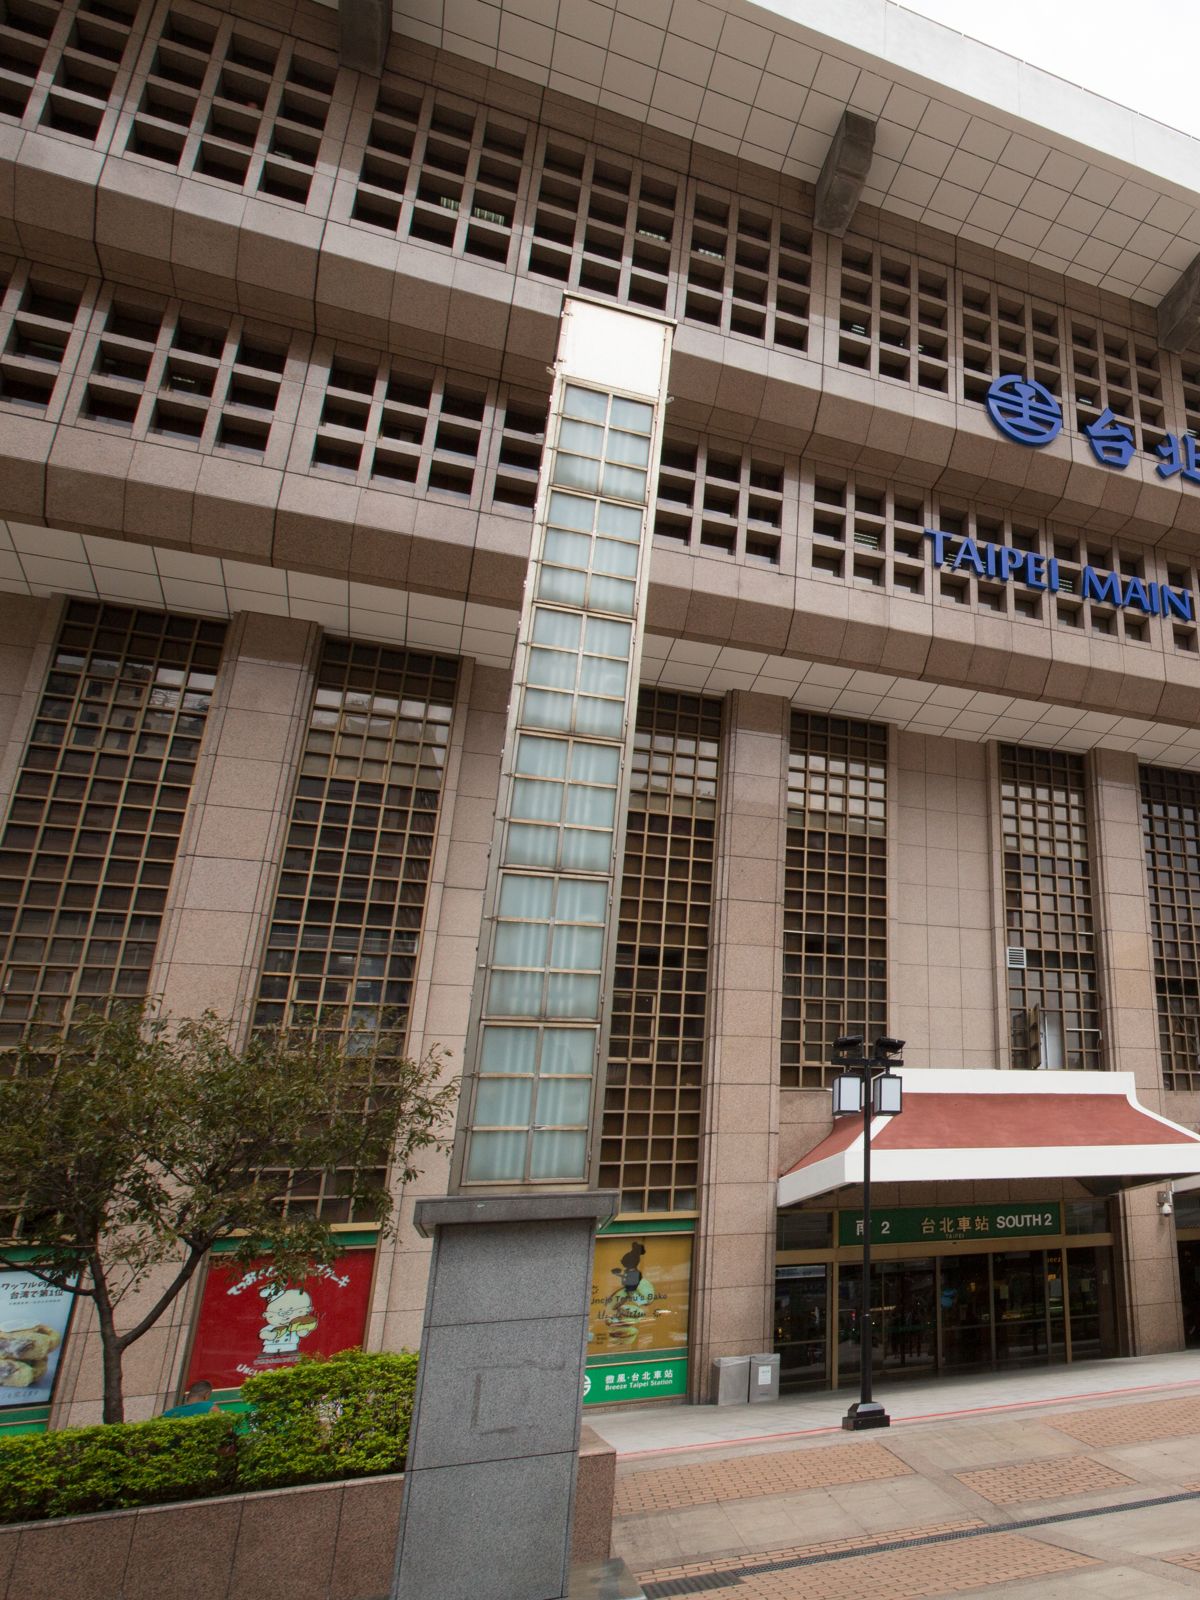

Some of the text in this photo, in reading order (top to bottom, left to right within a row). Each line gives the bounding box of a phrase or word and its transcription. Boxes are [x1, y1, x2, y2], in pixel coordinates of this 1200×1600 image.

[925, 529, 1060, 593] TAIPEI
[1083, 565, 1193, 622] MAIN
[881, 1221, 891, 1234] 2
[921, 1216, 989, 1234] 台北車站
[605, 1383, 628, 1391] Breeze
[630, 1380, 649, 1389] Taipei
